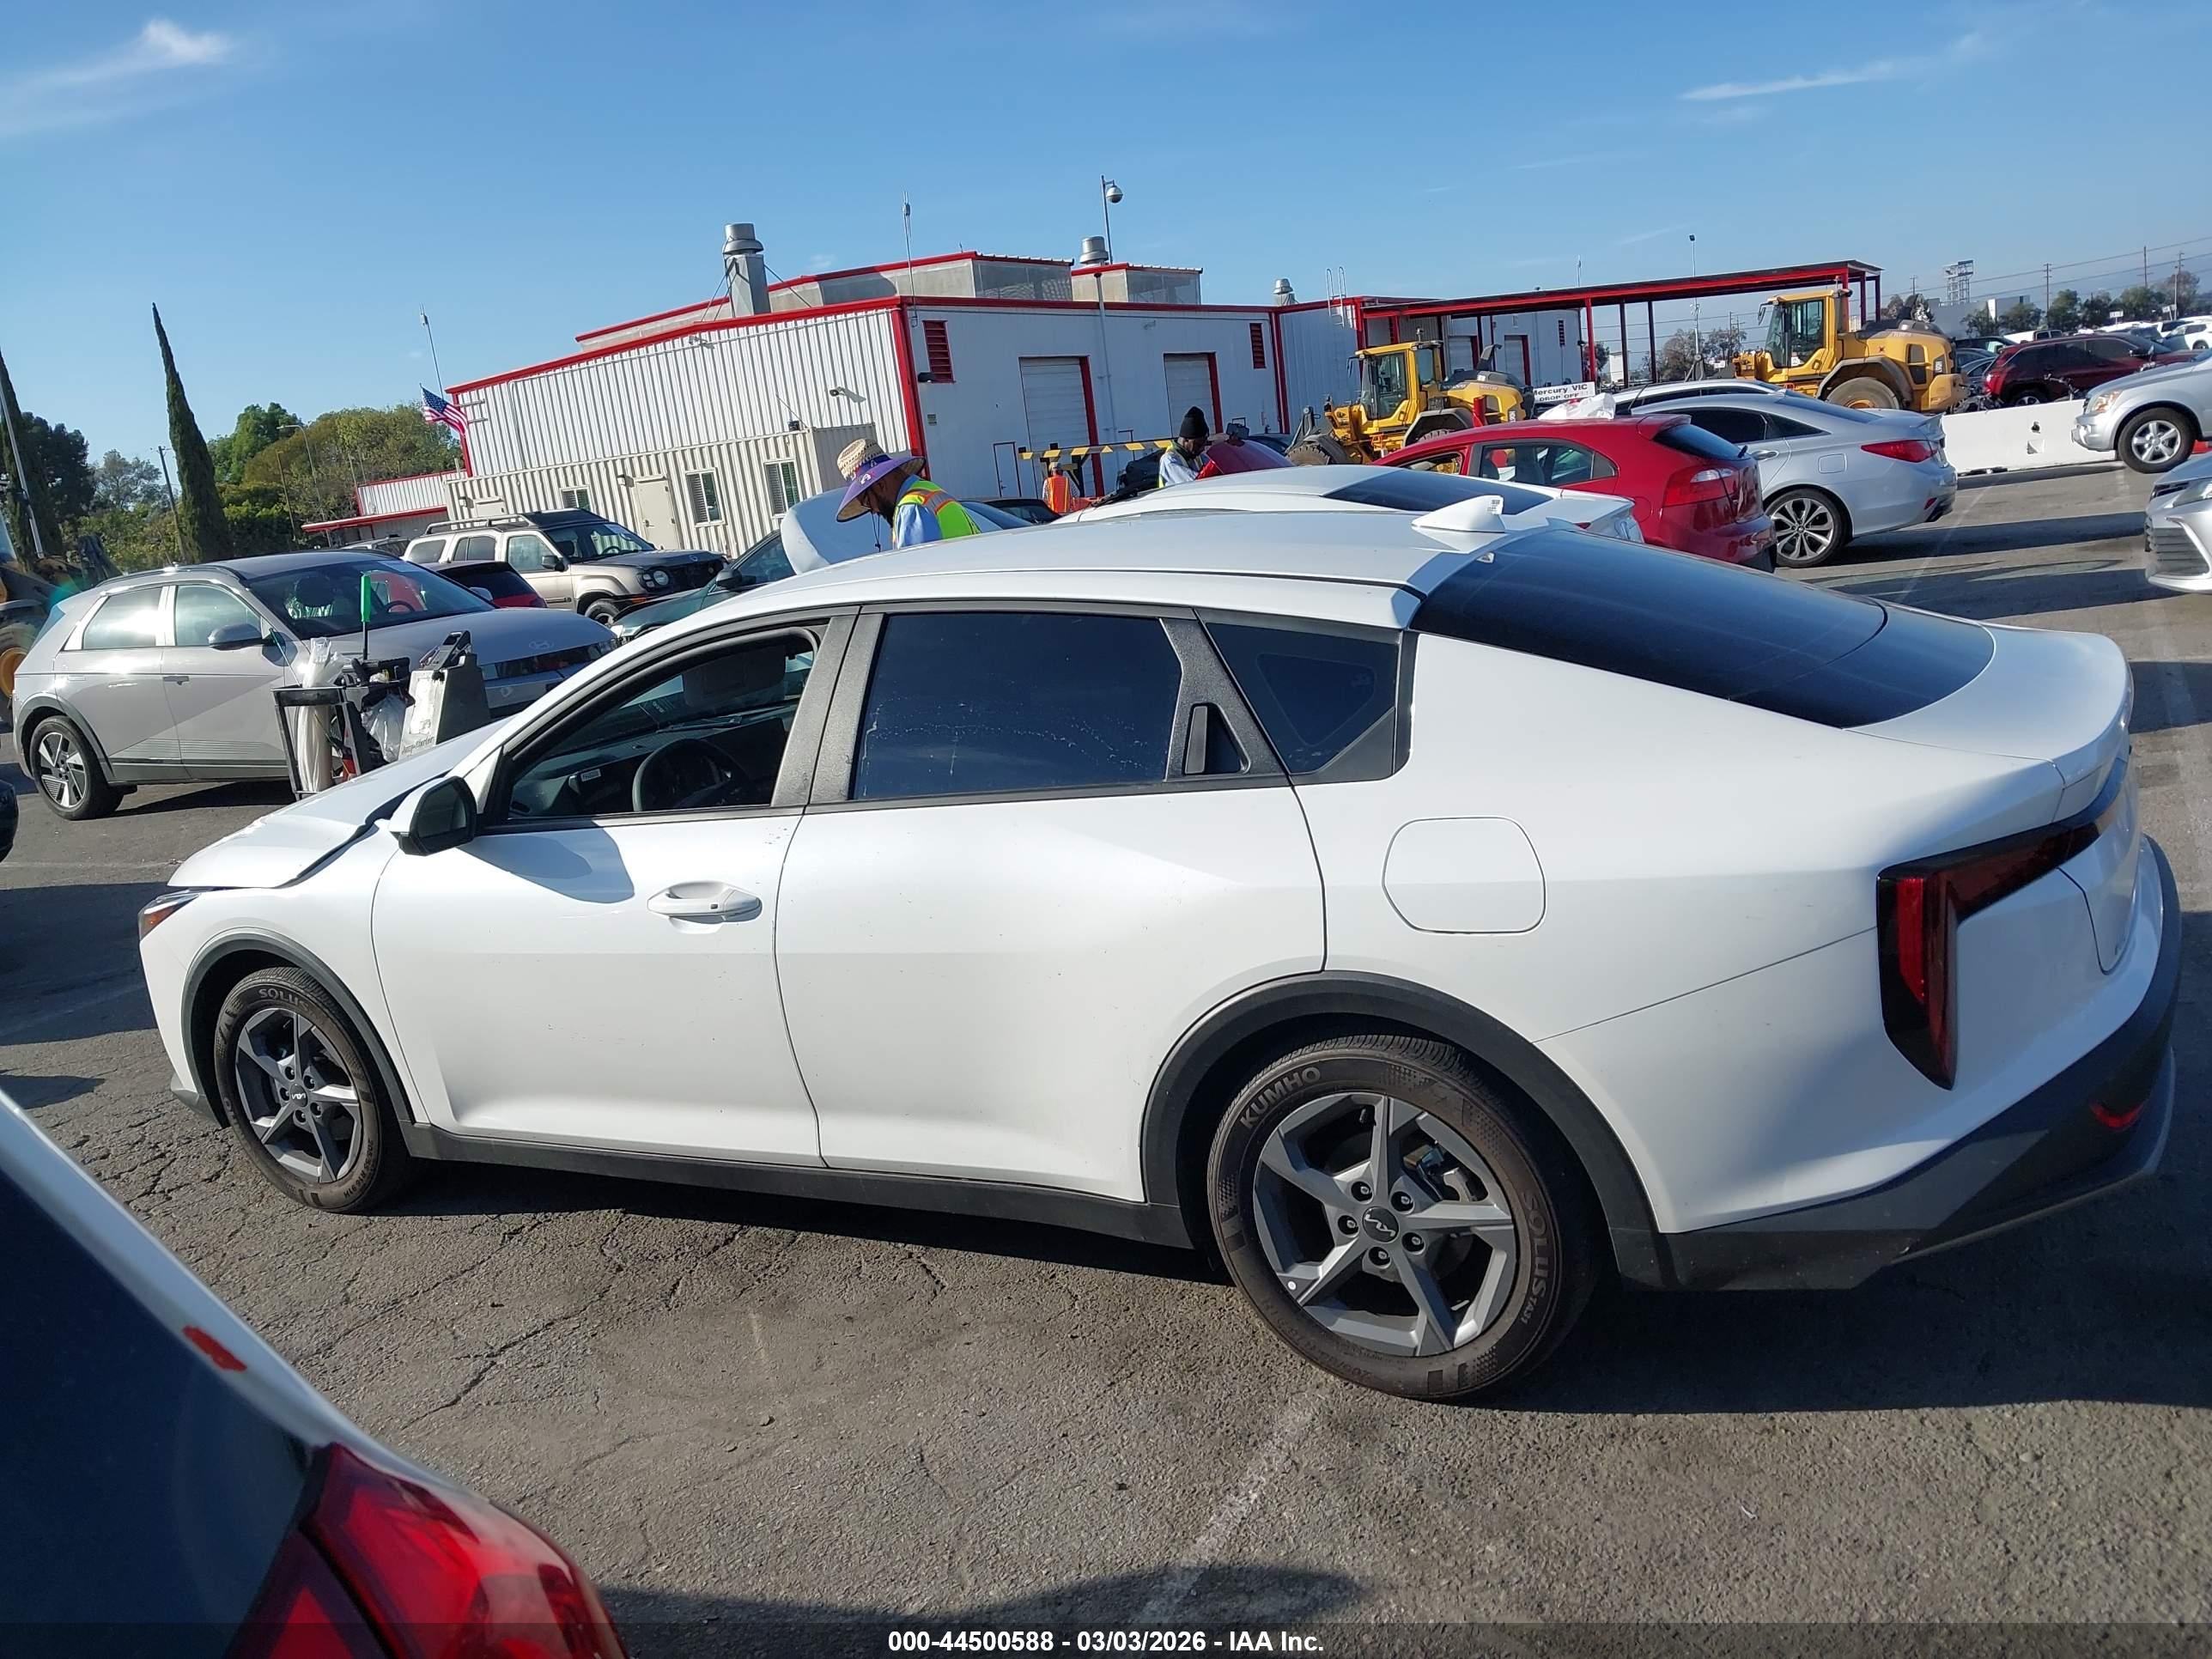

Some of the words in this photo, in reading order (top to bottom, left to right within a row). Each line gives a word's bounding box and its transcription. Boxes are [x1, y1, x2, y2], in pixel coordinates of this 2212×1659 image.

[258, 988, 309, 1012] SOLUS
[1239, 1066, 1321, 1129] KUMHO
[1521, 1191, 1549, 1297] SOLUS
